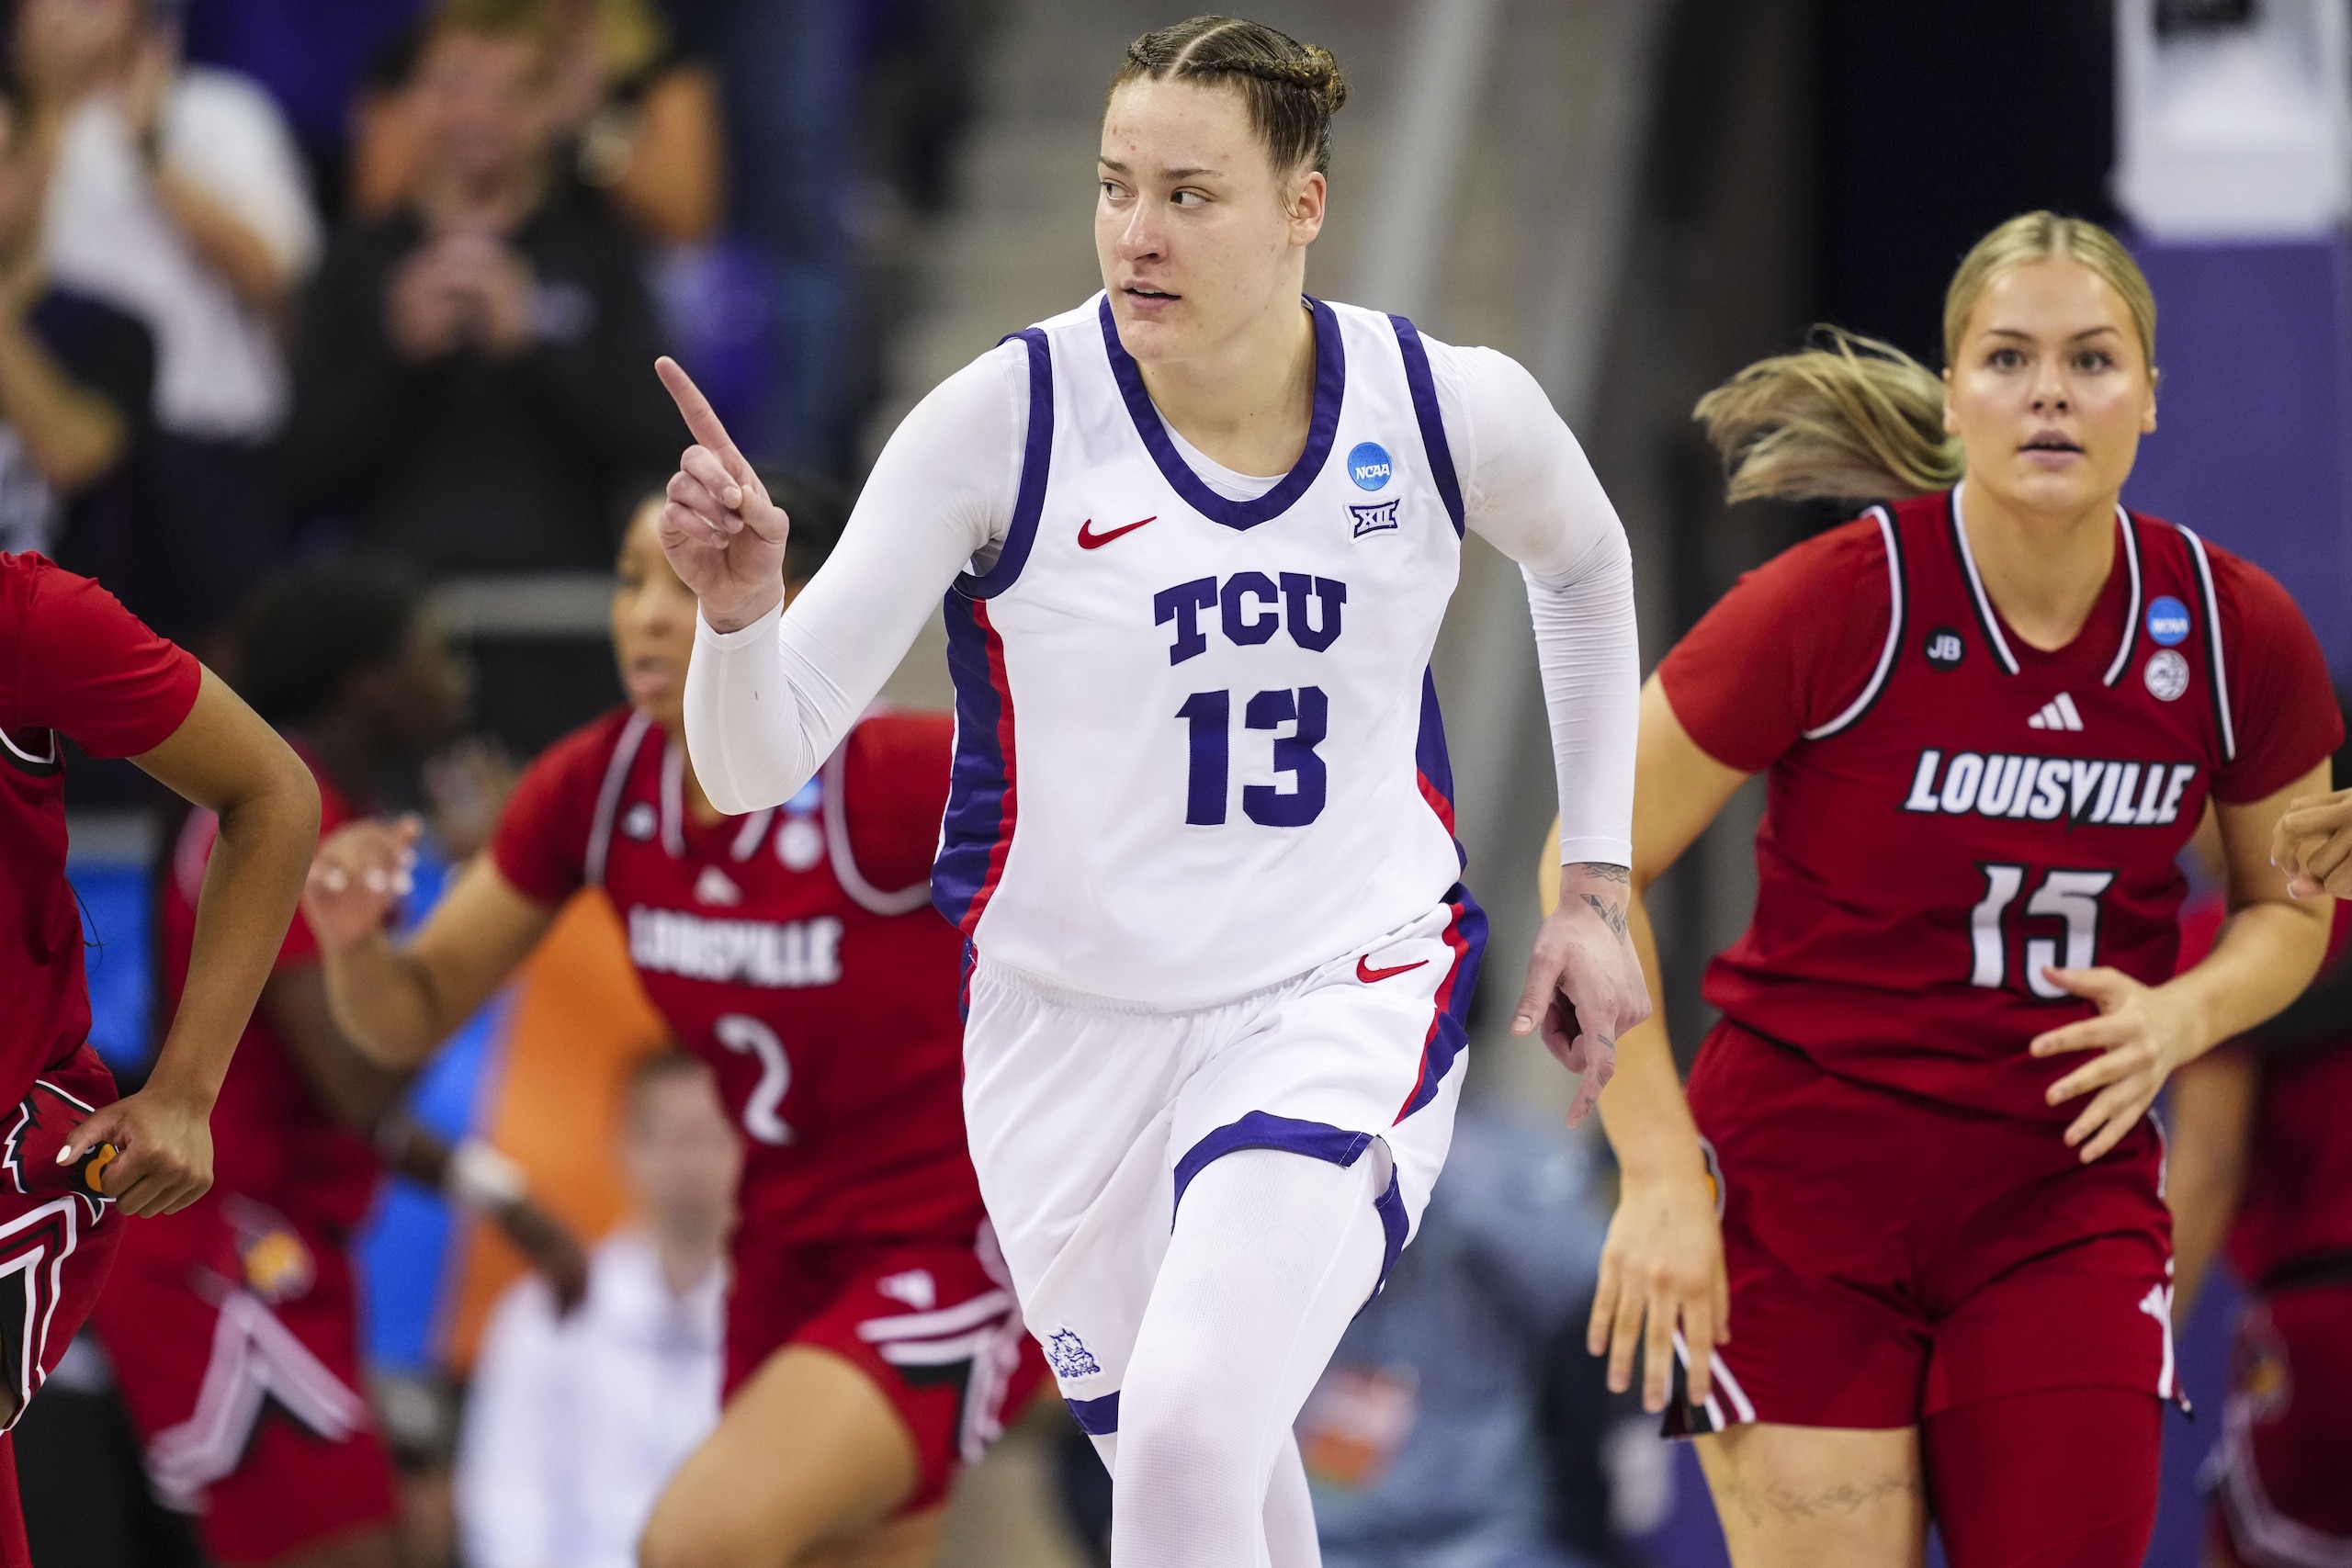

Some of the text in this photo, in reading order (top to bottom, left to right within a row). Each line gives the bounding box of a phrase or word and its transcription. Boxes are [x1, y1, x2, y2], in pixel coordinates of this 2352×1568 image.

[1355, 463, 1391, 479] NCAA
[1154, 571, 1347, 667] TCU
[1927, 634, 1962, 661] JB
[1174, 685, 1329, 828] 13
[1904, 749, 2198, 826] LOUISVILLE
[1971, 863, 2117, 999] 15
